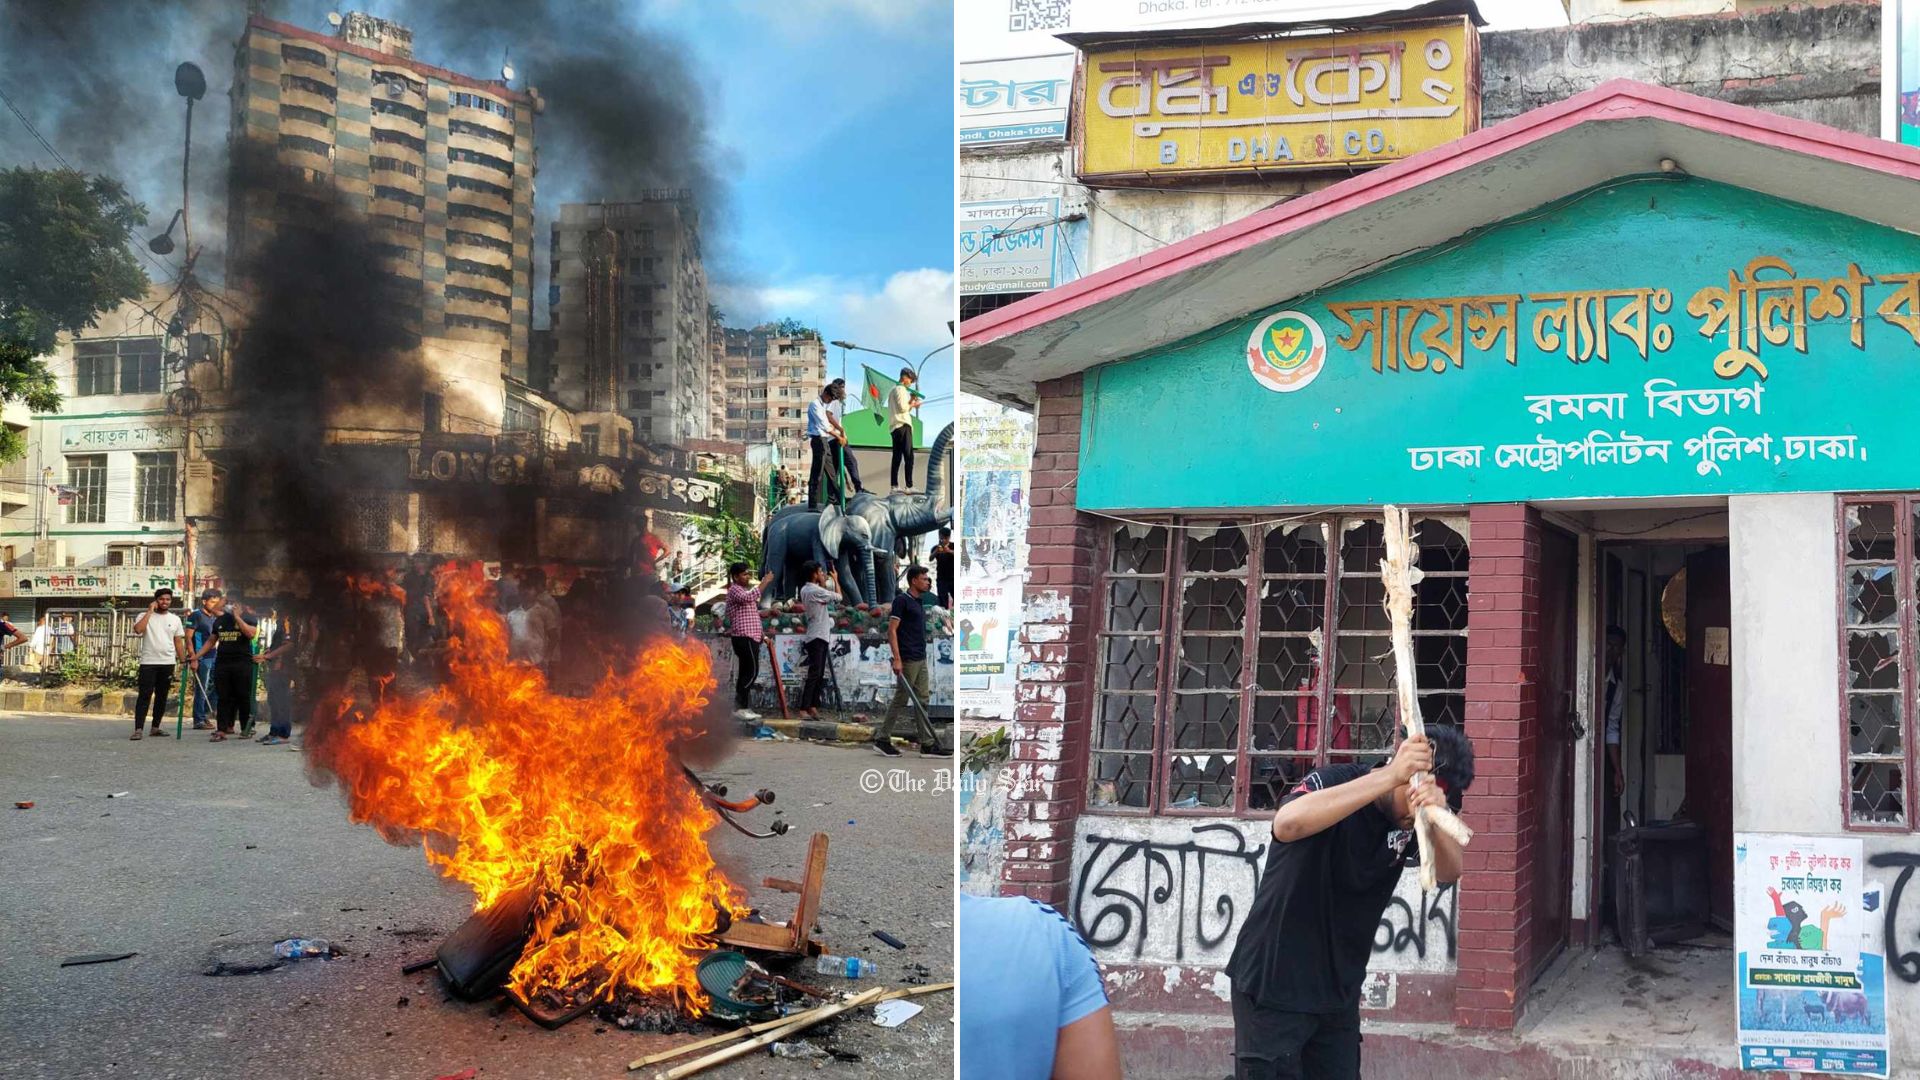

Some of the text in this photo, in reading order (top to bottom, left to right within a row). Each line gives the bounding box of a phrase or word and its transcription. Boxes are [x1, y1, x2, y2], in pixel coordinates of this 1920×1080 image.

[988, 126, 1057, 138] Dhaka-1205.
[960, 282, 1048, 293] study@gmail.com
[1324, 294, 1524, 375] সায়েন্স
[1687, 256, 1875, 382] পুলিশ
[1525, 378, 1766, 424] রমনা বিভাগ
[1408, 445, 1484, 471] ঢাকা
[1494, 429, 1673, 472] মেট্রোপলিটন
